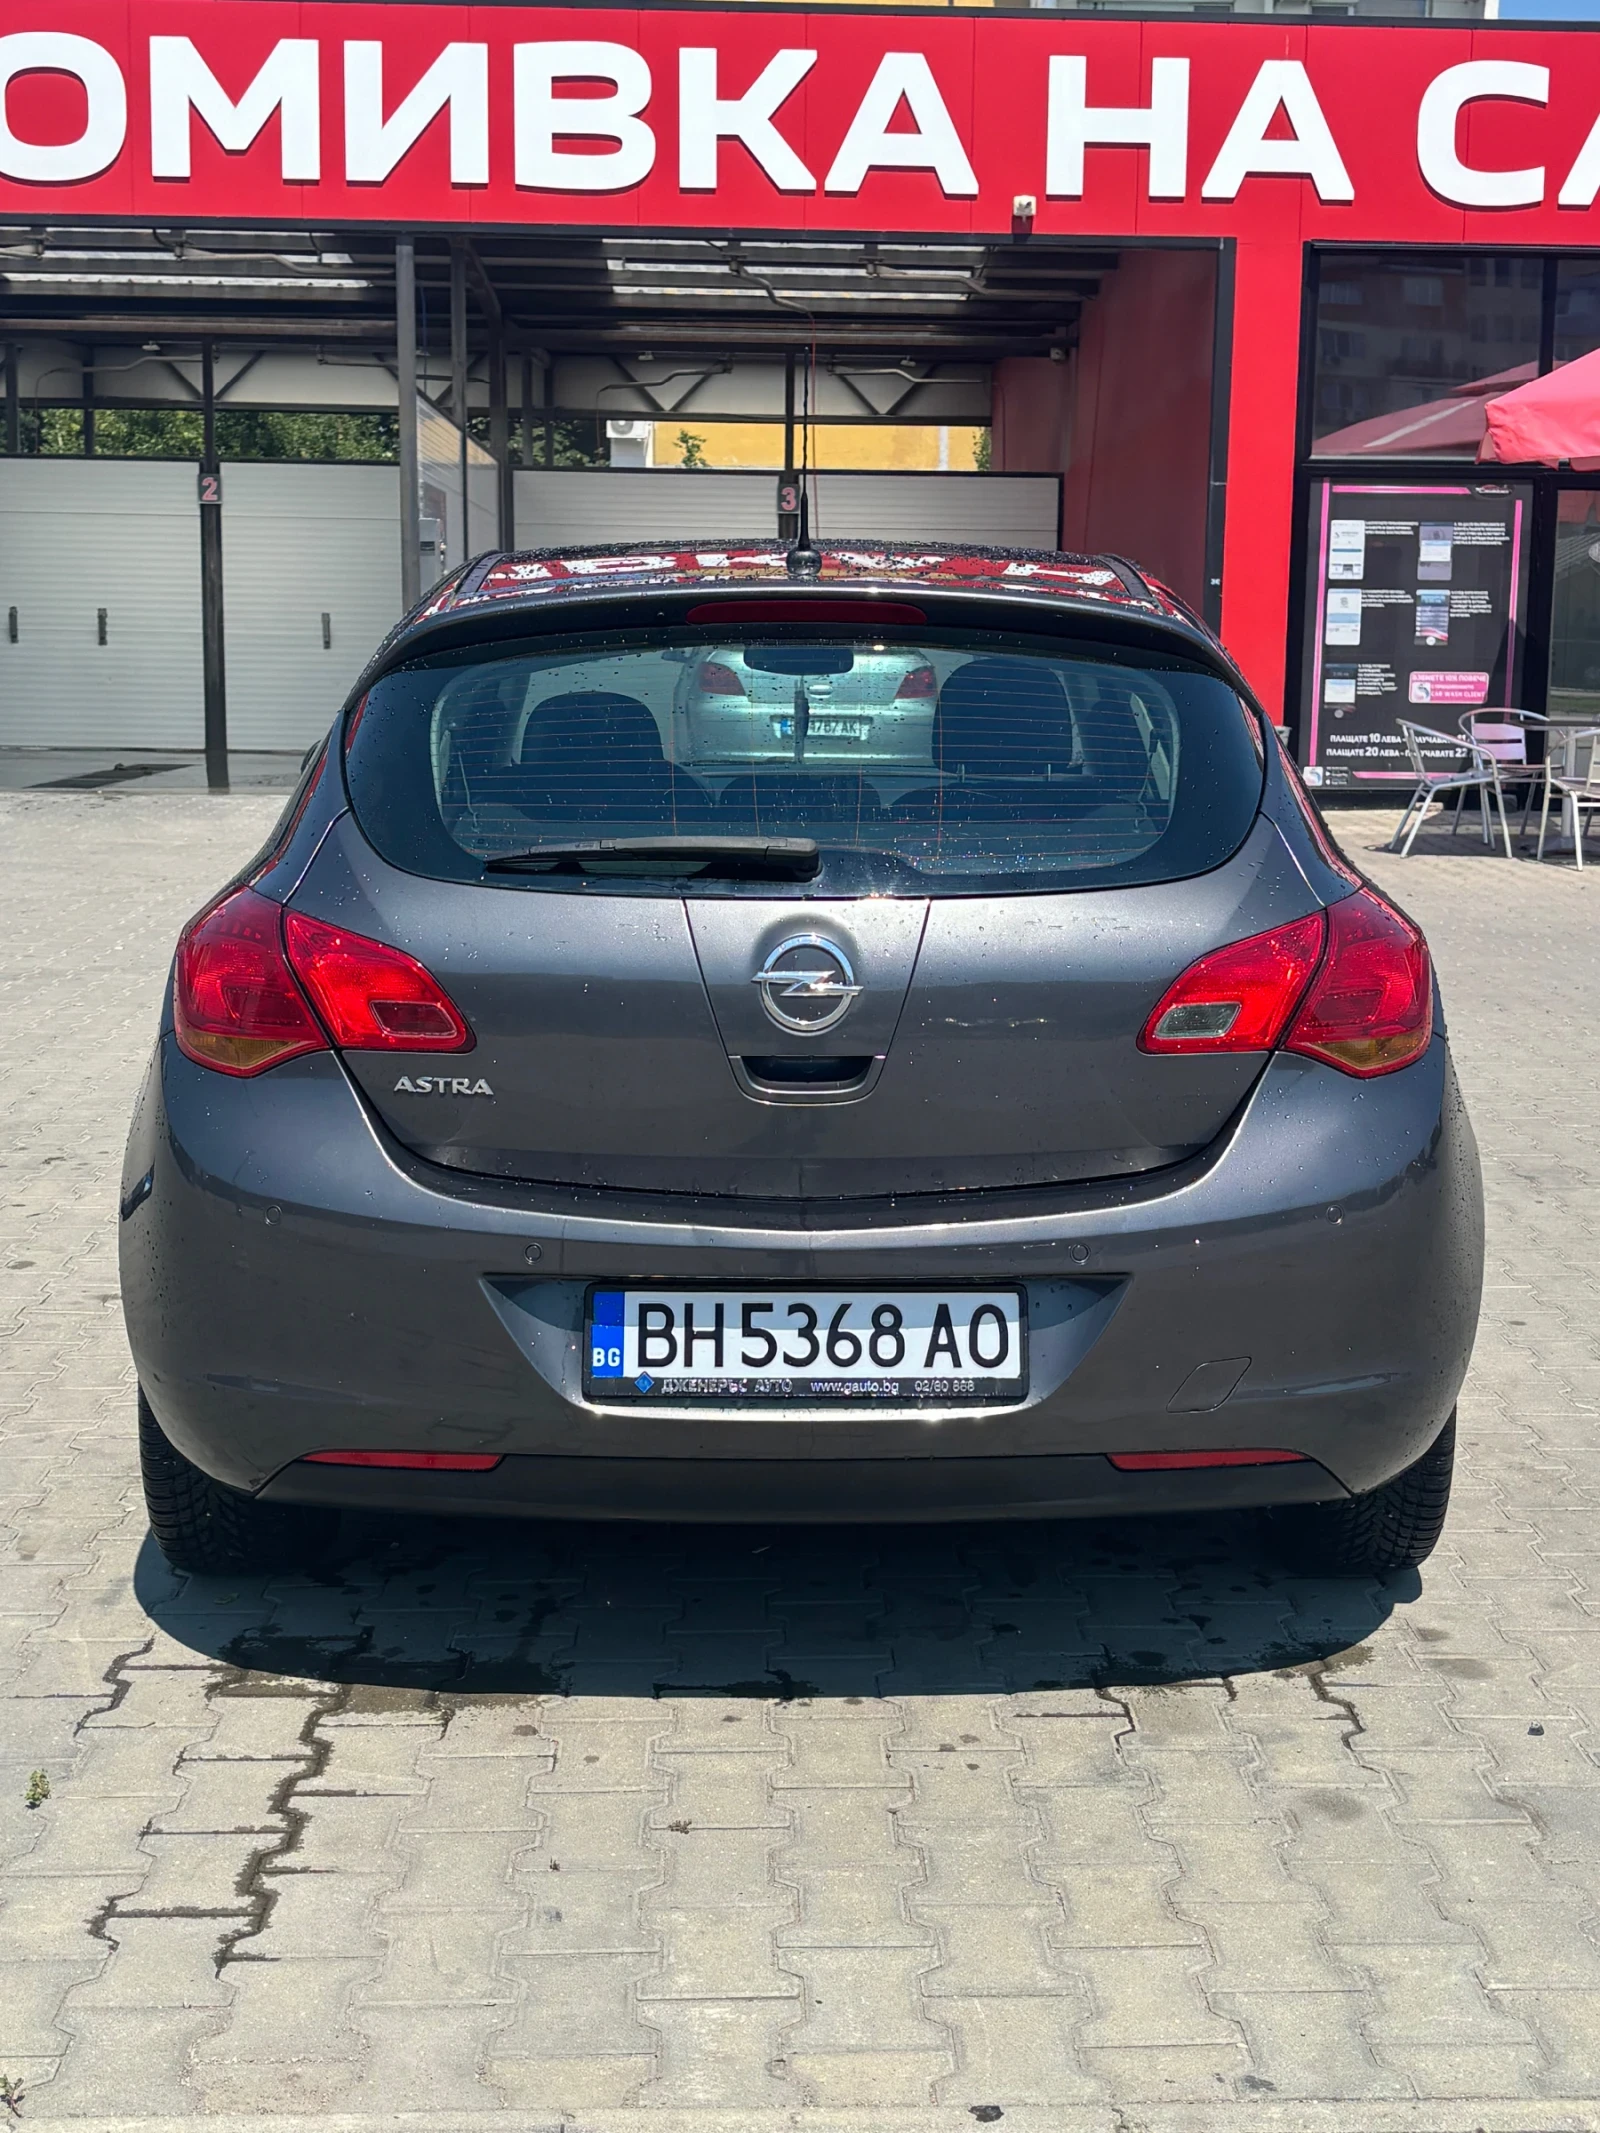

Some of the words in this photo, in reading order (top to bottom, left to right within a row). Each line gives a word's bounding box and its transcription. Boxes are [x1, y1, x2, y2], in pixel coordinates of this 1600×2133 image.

[0, 31, 980, 196] ОМИВКА
[1045, 54, 1355, 202] НА
[1417, 58, 1600, 209] С
[202, 476, 218, 501] 2
[781, 486, 797, 511] 3
[1330, 735, 1368, 743] ПЛАЩАТЕ
[1369, 733, 1380, 743] 10
[1381, 735, 1401, 743] ЛЕВА
[1326, 748, 1364, 757] ПЛАЩАТЕ
[1365, 746, 1379, 756] 20
[1380, 749, 1399, 757] ЛЕВА
[393, 1076, 494, 1095] ASTRA
[637, 1302, 725, 1368] BH
[740, 1302, 906, 1369] 5368
[592, 1347, 620, 1367] BG
[810, 1380, 899, 1395] www.gauto.bg
